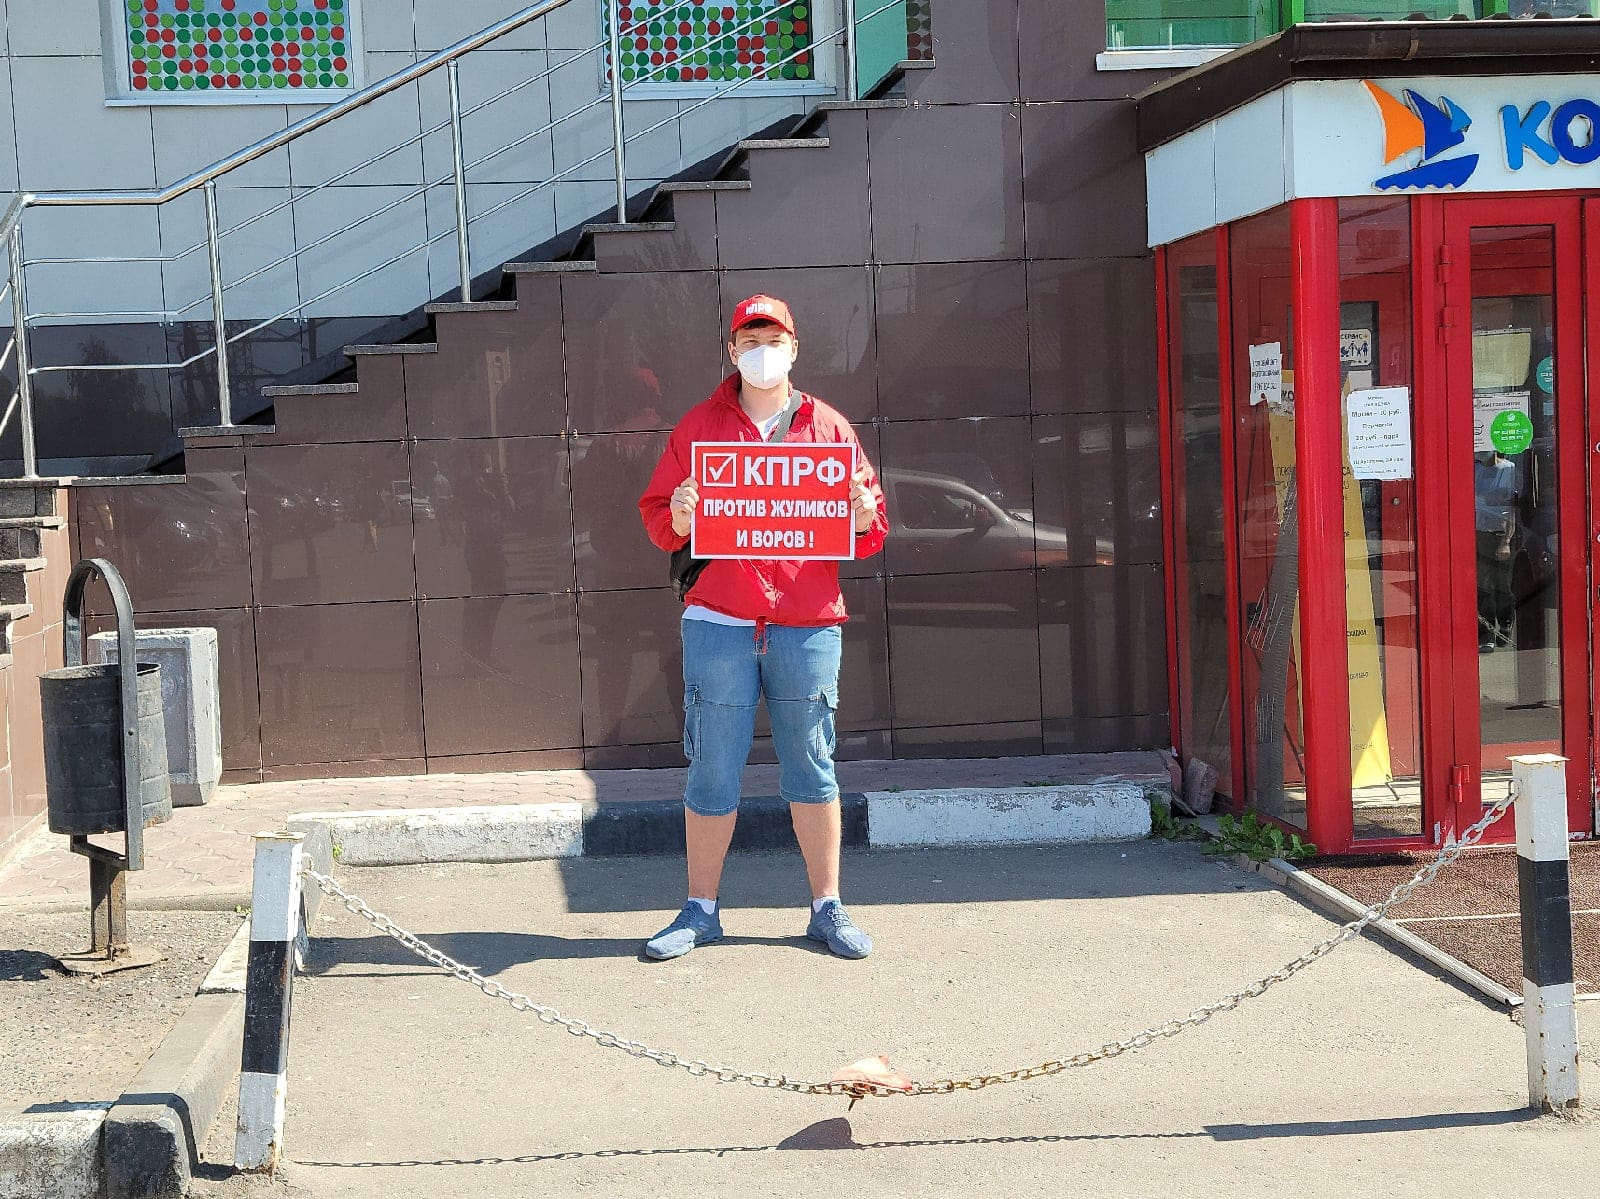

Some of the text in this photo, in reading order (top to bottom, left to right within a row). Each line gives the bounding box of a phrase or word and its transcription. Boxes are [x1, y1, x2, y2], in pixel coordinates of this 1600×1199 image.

[1499, 98, 1600, 171] КО
[745, 302, 774, 315] КПРФ
[744, 455, 846, 487] КПРФ
[703, 498, 848, 518] ПРОТИВ ЖУЛИКОВ
[736, 530, 749, 548] И
[751, 530, 806, 548] ВОРОВ
